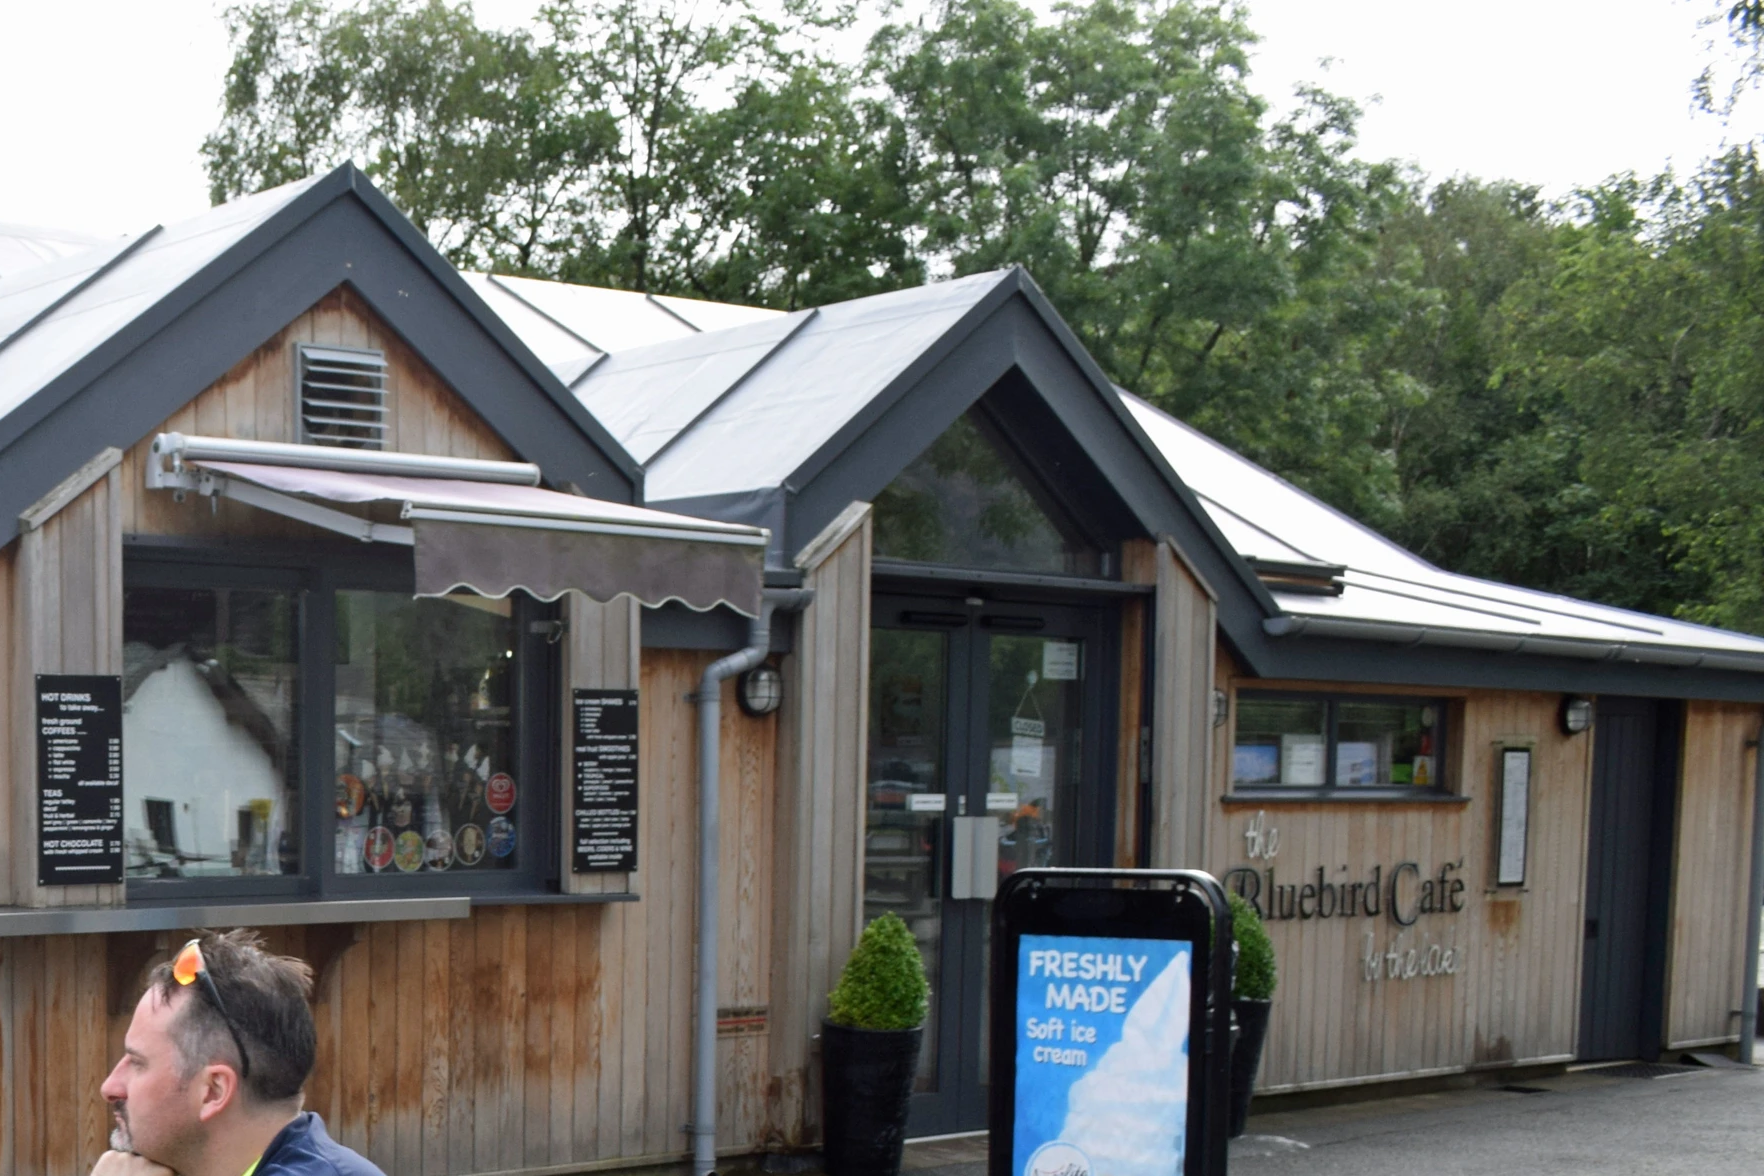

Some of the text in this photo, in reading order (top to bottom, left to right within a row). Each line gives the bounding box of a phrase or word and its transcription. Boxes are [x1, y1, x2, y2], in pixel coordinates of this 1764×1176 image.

[41, 693, 92, 702] HOT DRINKS
[43, 789, 63, 797] TEAS
[43, 840, 59, 848] HOT
[60, 839, 104, 847] CHOCOLATE
[1245, 809, 1279, 860] the
[1223, 857, 1465, 927] Bluebird Café
[1028, 949, 1148, 983] FRESHLY
[1386, 931, 1418, 980] the
[1044, 982, 1128, 1014] MADE
[1025, 1017, 1097, 1044] Soft ice
[1033, 1045, 1087, 1067] cream
